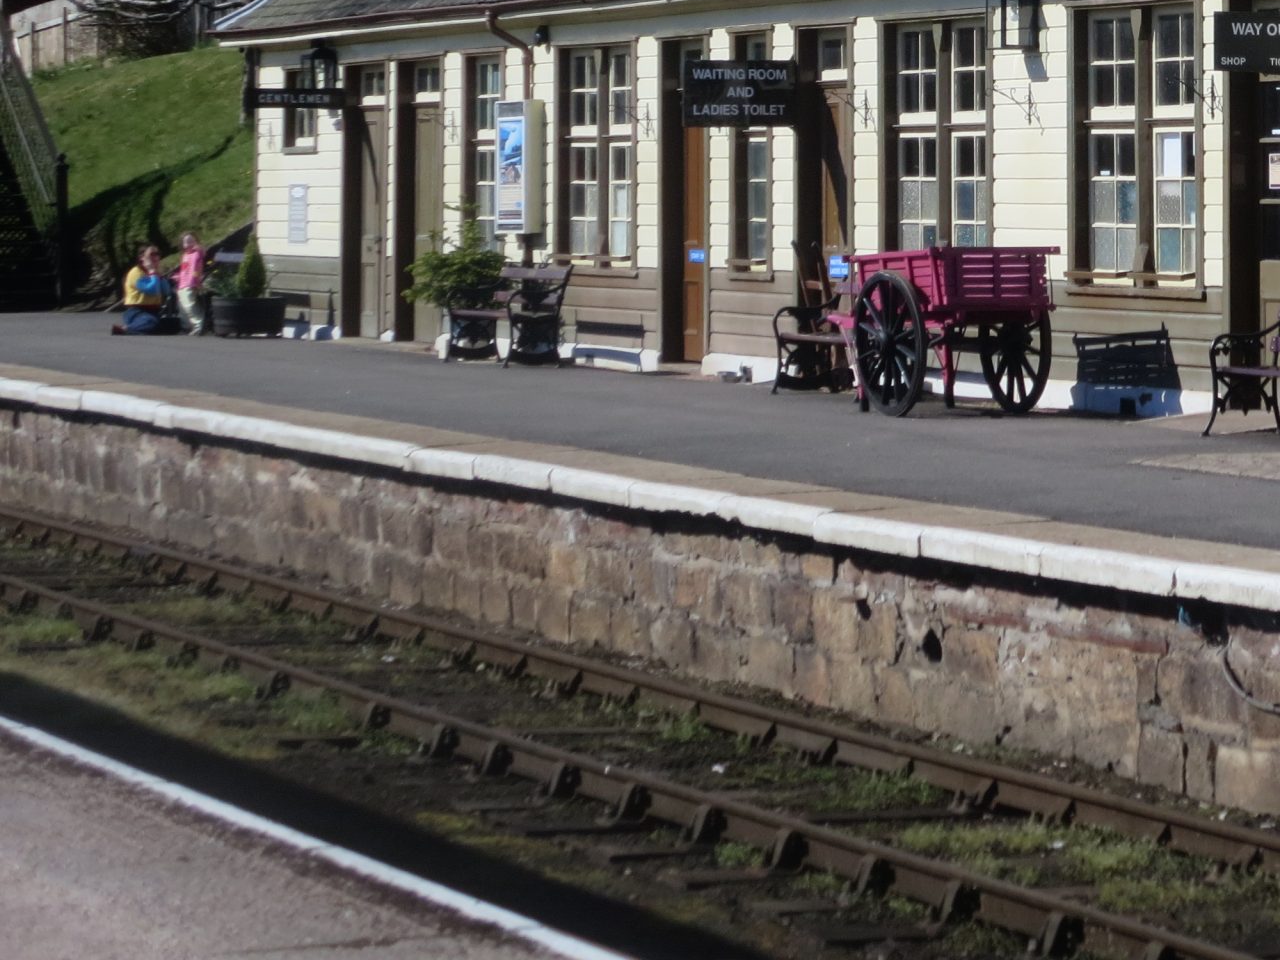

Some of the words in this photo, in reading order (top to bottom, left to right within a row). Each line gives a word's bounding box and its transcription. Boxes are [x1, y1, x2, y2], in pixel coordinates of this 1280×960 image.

[1231, 22, 1263, 36] WAY
[1220, 56, 1247, 66] SHOP
[692, 68, 746, 81] WAITING
[748, 68, 788, 81] ROOM
[726, 86, 755, 98] AND
[258, 93, 330, 104] GENTLEMEN
[692, 104, 740, 116] LADIES
[742, 104, 786, 116] TOILET
